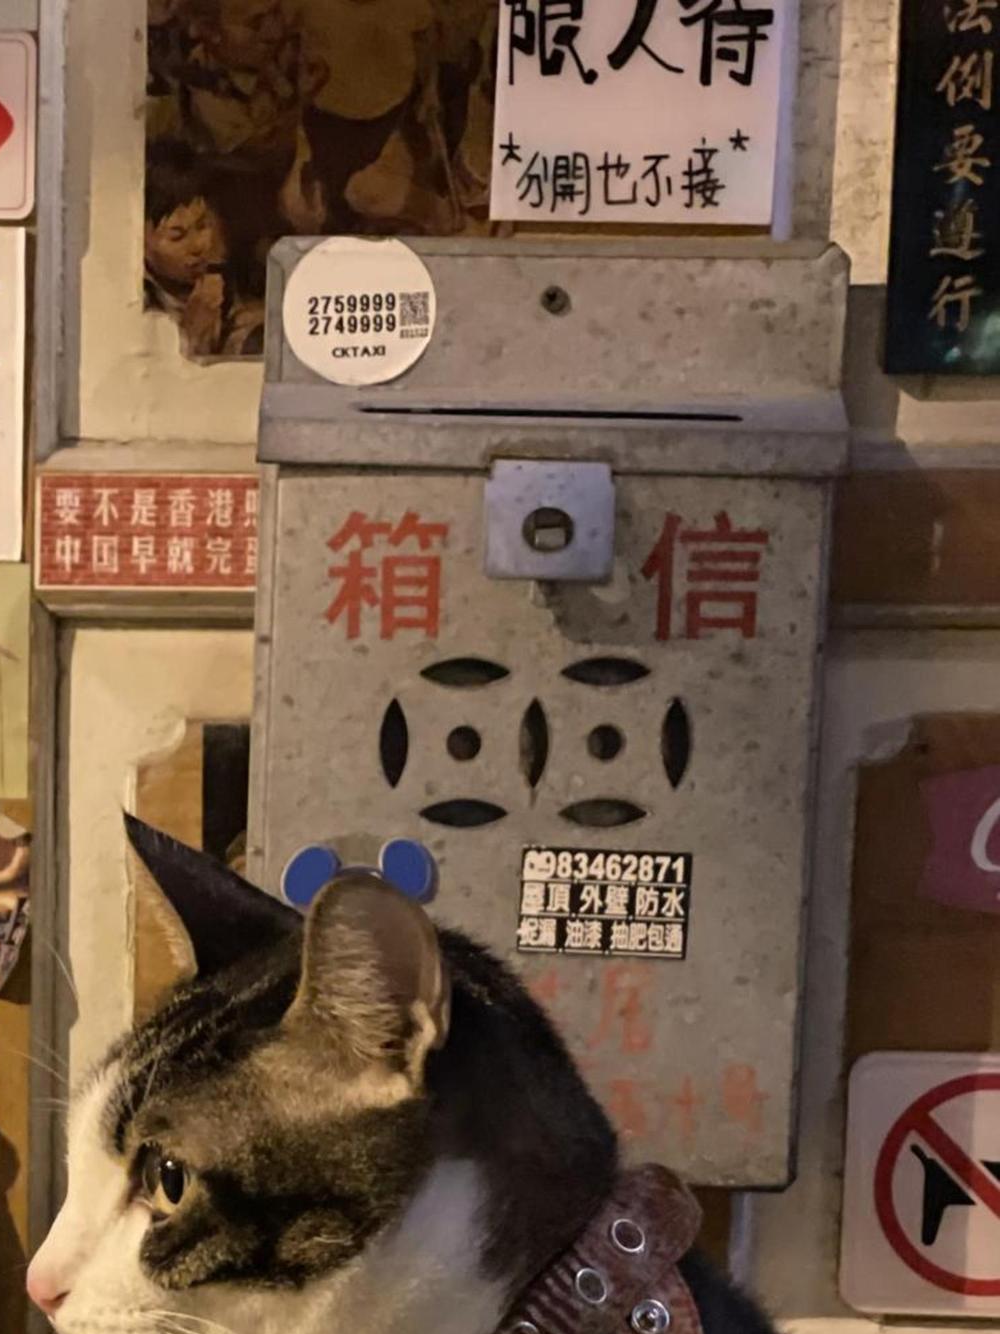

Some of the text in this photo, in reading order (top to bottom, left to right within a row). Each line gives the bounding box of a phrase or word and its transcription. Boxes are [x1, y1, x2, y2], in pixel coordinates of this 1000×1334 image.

[308, 291, 397, 316] 2759999
[308, 313, 397, 336] 2749999
[331, 345, 387, 359] CKTAXI
[635, 885, 685, 916] 防水
